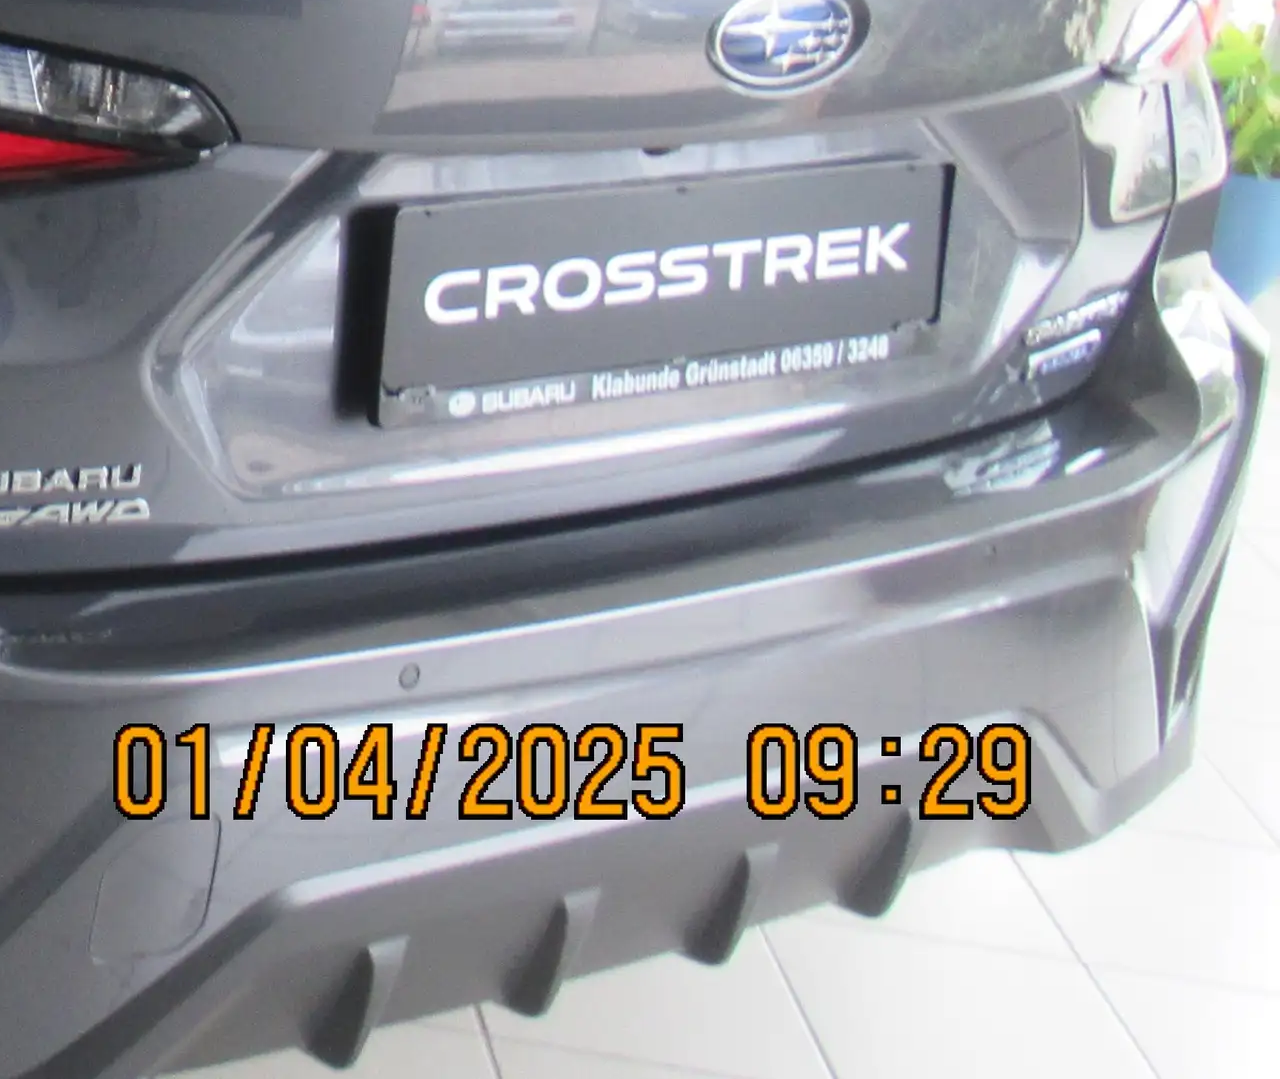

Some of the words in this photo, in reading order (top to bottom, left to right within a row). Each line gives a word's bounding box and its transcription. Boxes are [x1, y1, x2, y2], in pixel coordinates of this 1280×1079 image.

[424, 221, 911, 325] CROSSTREK
[482, 381, 575, 413] SUBARU
[591, 365, 680, 400] Klabunde
[685, 350, 777, 387] Grünstadt
[17, 497, 151, 527] AWD
